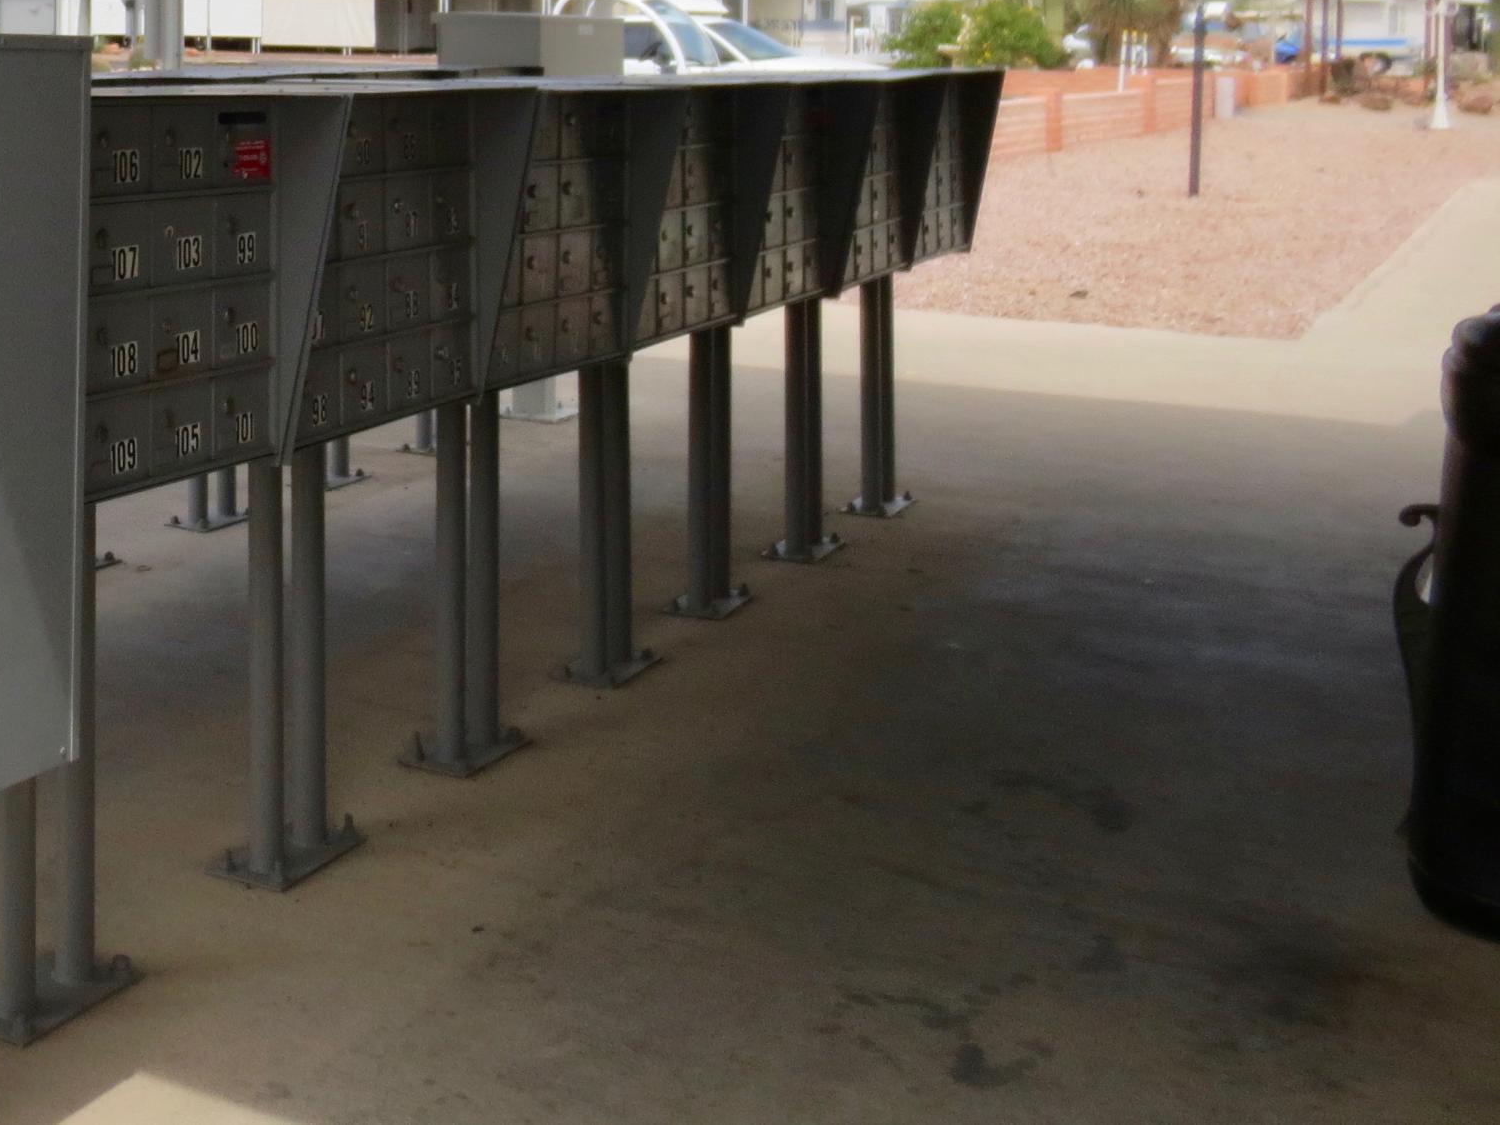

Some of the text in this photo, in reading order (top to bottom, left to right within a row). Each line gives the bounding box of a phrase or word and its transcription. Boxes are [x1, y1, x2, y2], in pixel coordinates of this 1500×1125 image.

[113, 150, 139, 184] 106
[179, 149, 202, 180] 102
[112, 246, 139, 280] 107
[177, 237, 201, 270] 103
[237, 234, 255, 264] 99
[176, 331, 199, 364] 104
[236, 322, 259, 355] 100
[111, 342, 137, 377] 108
[312, 394, 327, 424] 98
[176, 424, 199, 457] 105
[236, 413, 254, 444] 101
[111, 439, 137, 475] 109
